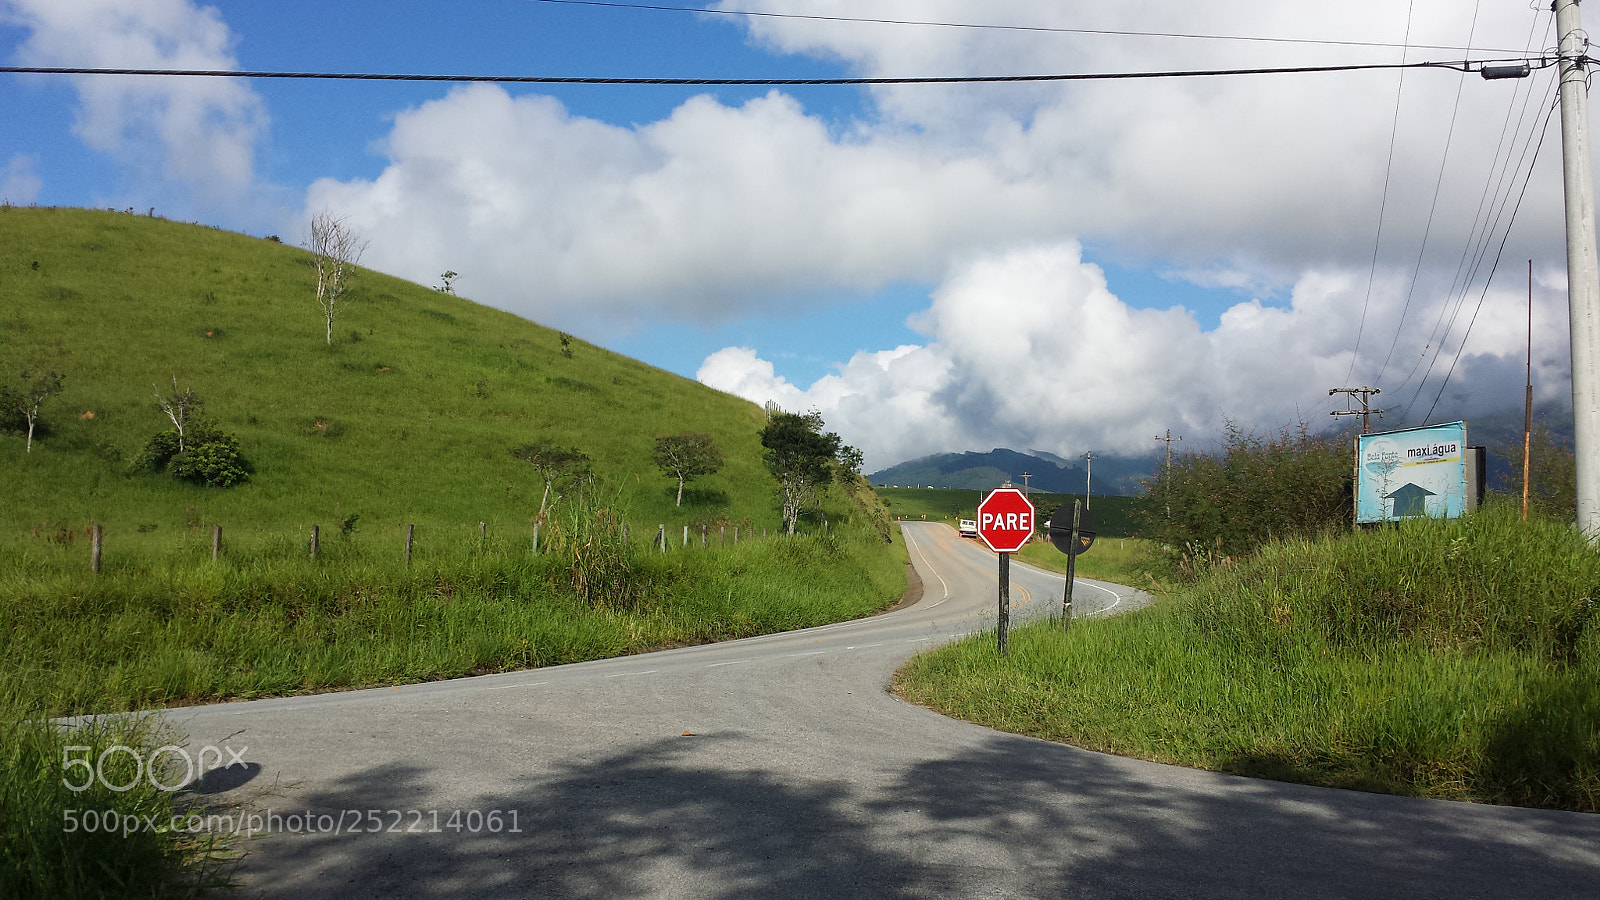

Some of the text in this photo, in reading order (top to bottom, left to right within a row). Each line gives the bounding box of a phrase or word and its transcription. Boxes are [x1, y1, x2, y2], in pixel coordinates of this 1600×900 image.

[1407, 443, 1456, 458] maxi água
[982, 512, 1030, 531] PARE
